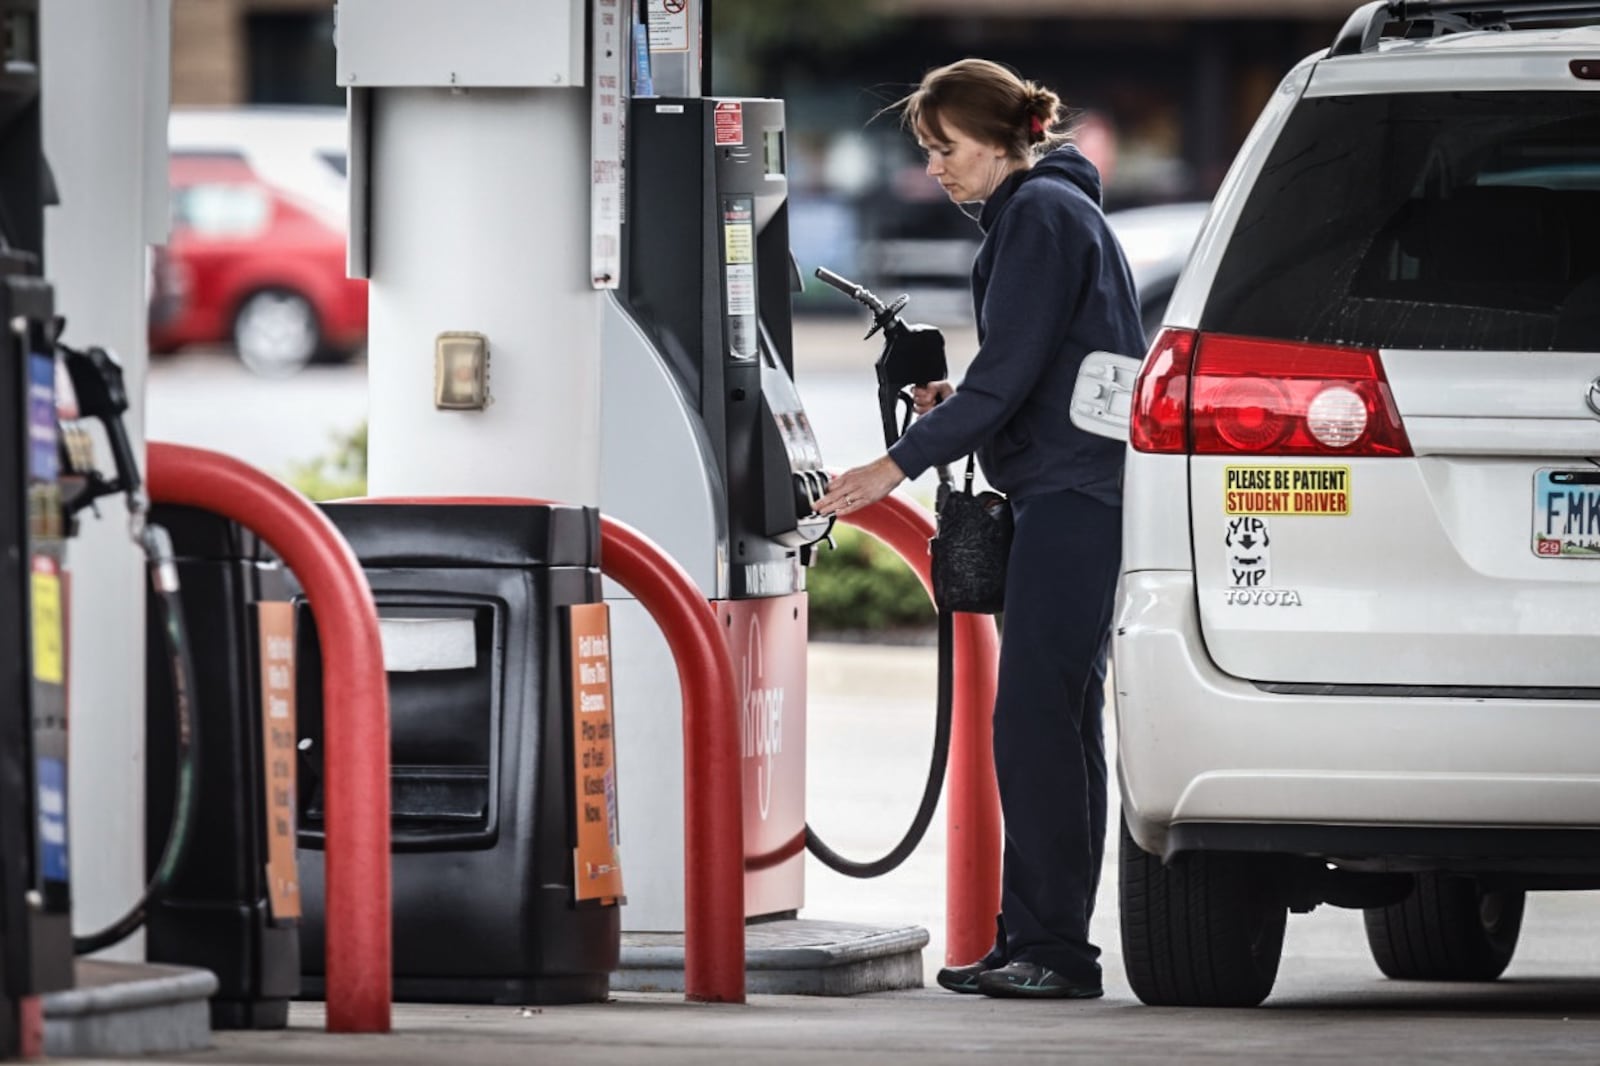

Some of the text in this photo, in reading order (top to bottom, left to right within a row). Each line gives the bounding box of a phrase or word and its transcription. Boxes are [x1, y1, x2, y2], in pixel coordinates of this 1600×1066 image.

[1228, 470, 1345, 490] PLEASE BE PATIENT
[1228, 492, 1346, 512] STUDENT DRIVER
[1229, 517, 1264, 535] YIP
[1539, 542, 1559, 554] 29
[1232, 568, 1266, 587] YIP
[1224, 589, 1302, 606] TOYOTA
[742, 613, 784, 821] Kroger
